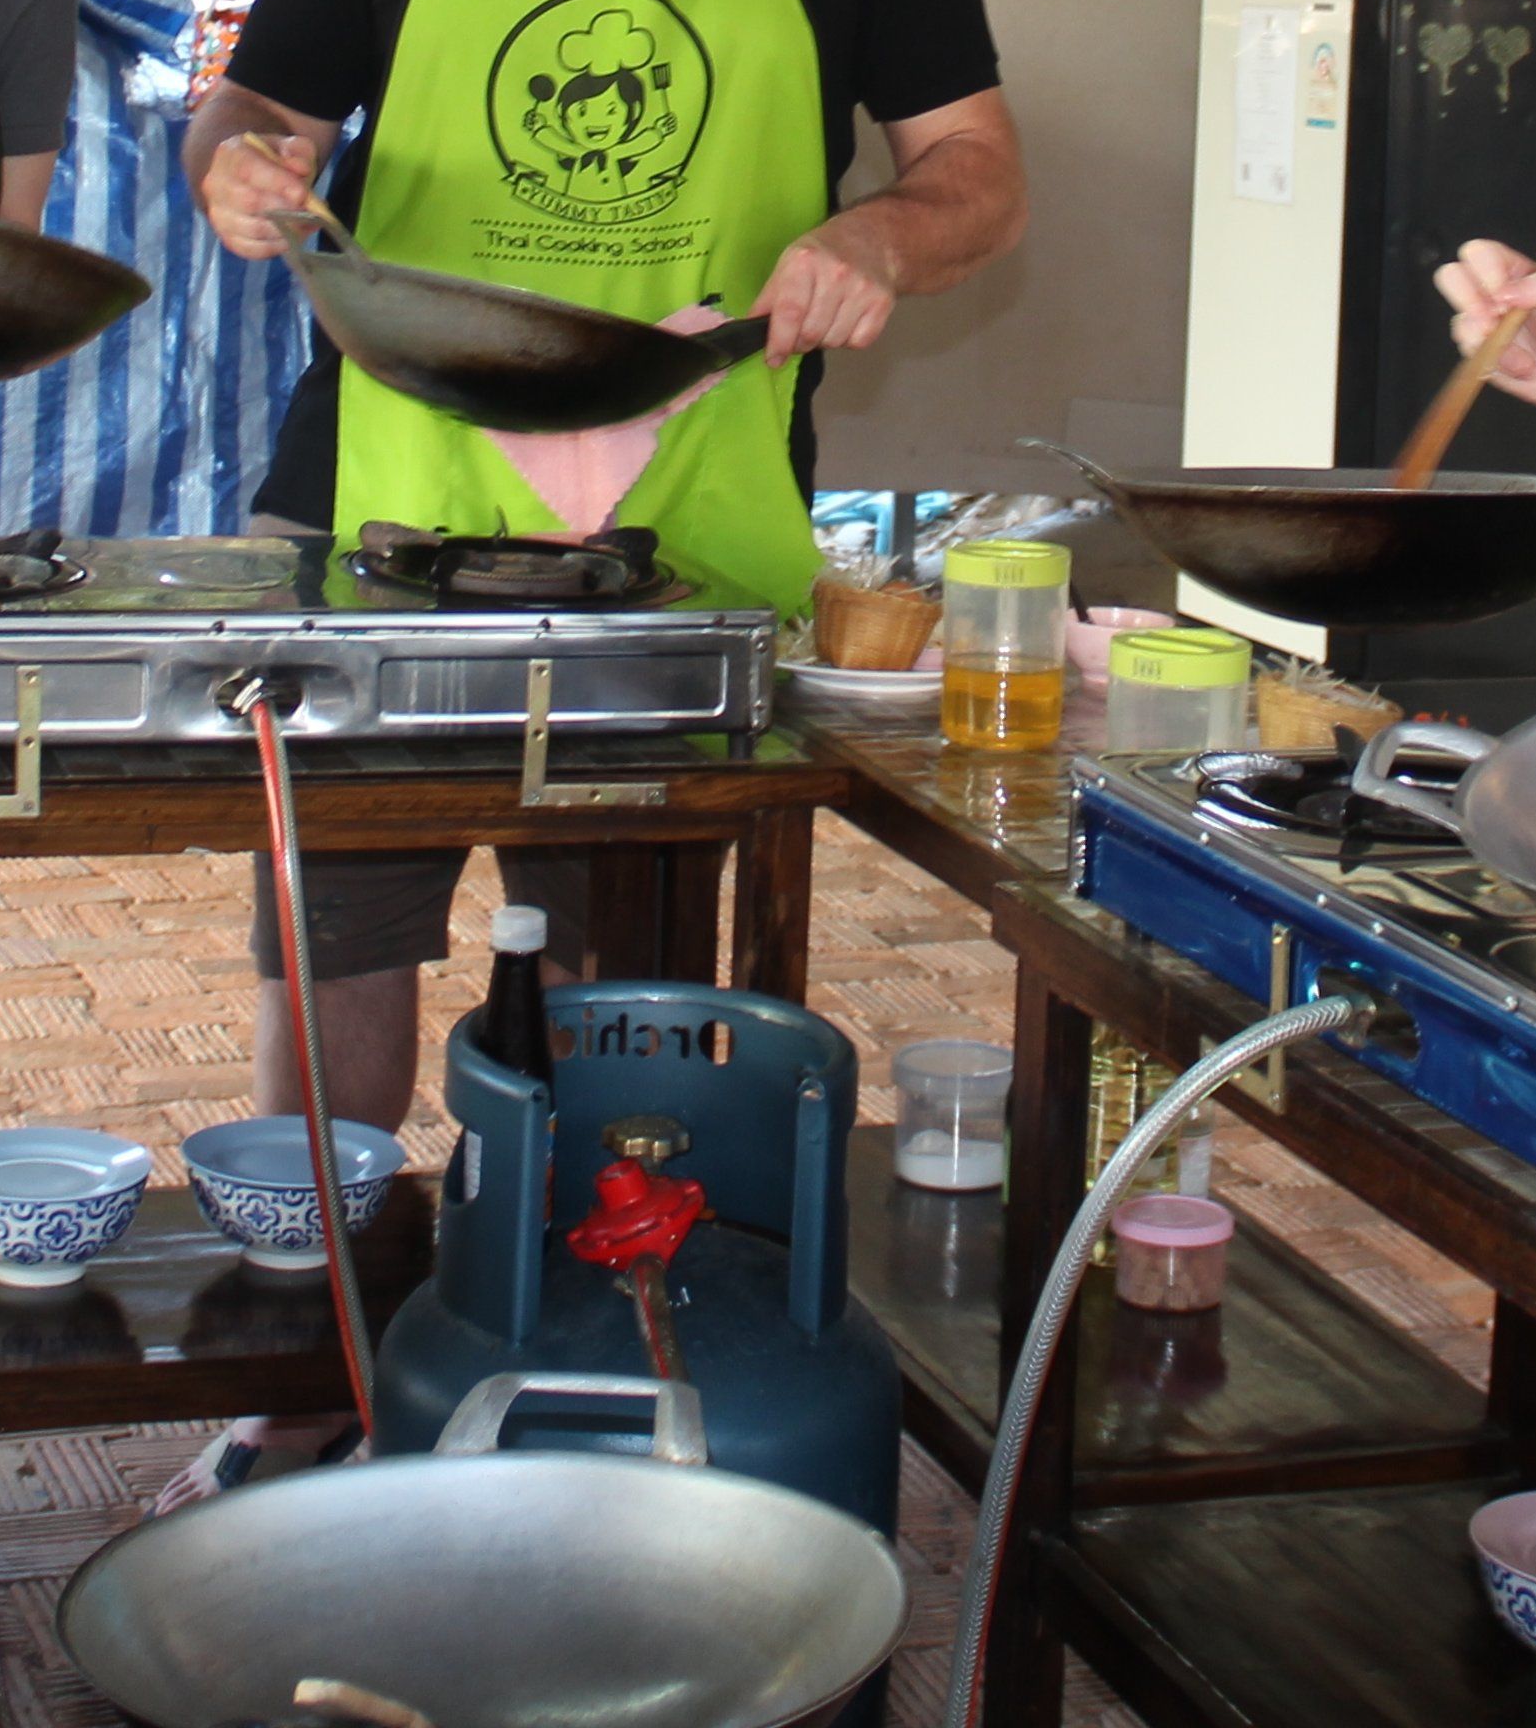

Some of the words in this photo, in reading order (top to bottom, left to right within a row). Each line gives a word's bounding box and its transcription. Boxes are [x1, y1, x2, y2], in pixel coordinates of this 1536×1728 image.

[528, 186, 601, 221] YUMMY
[609, 191, 666, 221] TASTY
[485, 230, 530, 249] Thai
[535, 233, 625, 257] Cooking
[630, 231, 694, 253] School
